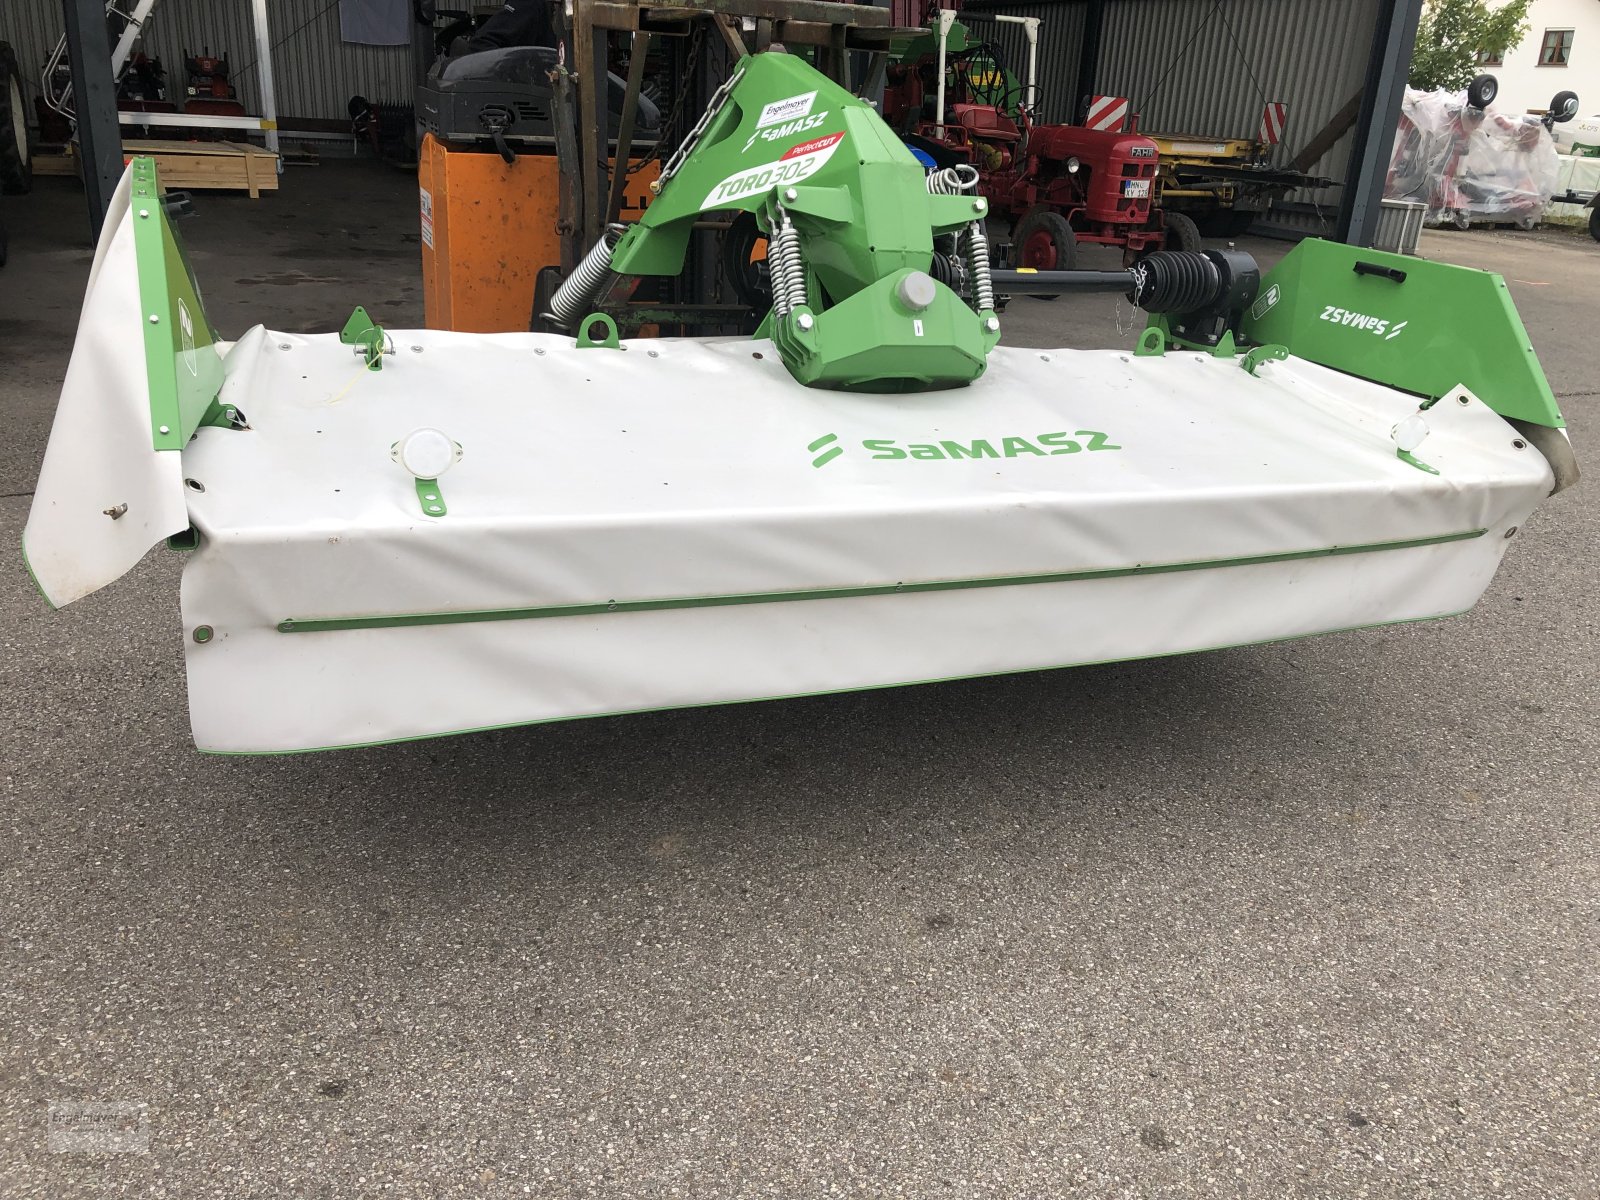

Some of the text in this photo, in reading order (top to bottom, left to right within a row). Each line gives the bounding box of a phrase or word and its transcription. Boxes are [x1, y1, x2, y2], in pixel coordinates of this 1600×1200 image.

[766, 98, 810, 116] Engelmayer
[792, 136, 837, 155] PerfectCUT
[1131, 148, 1154, 158] FAHR
